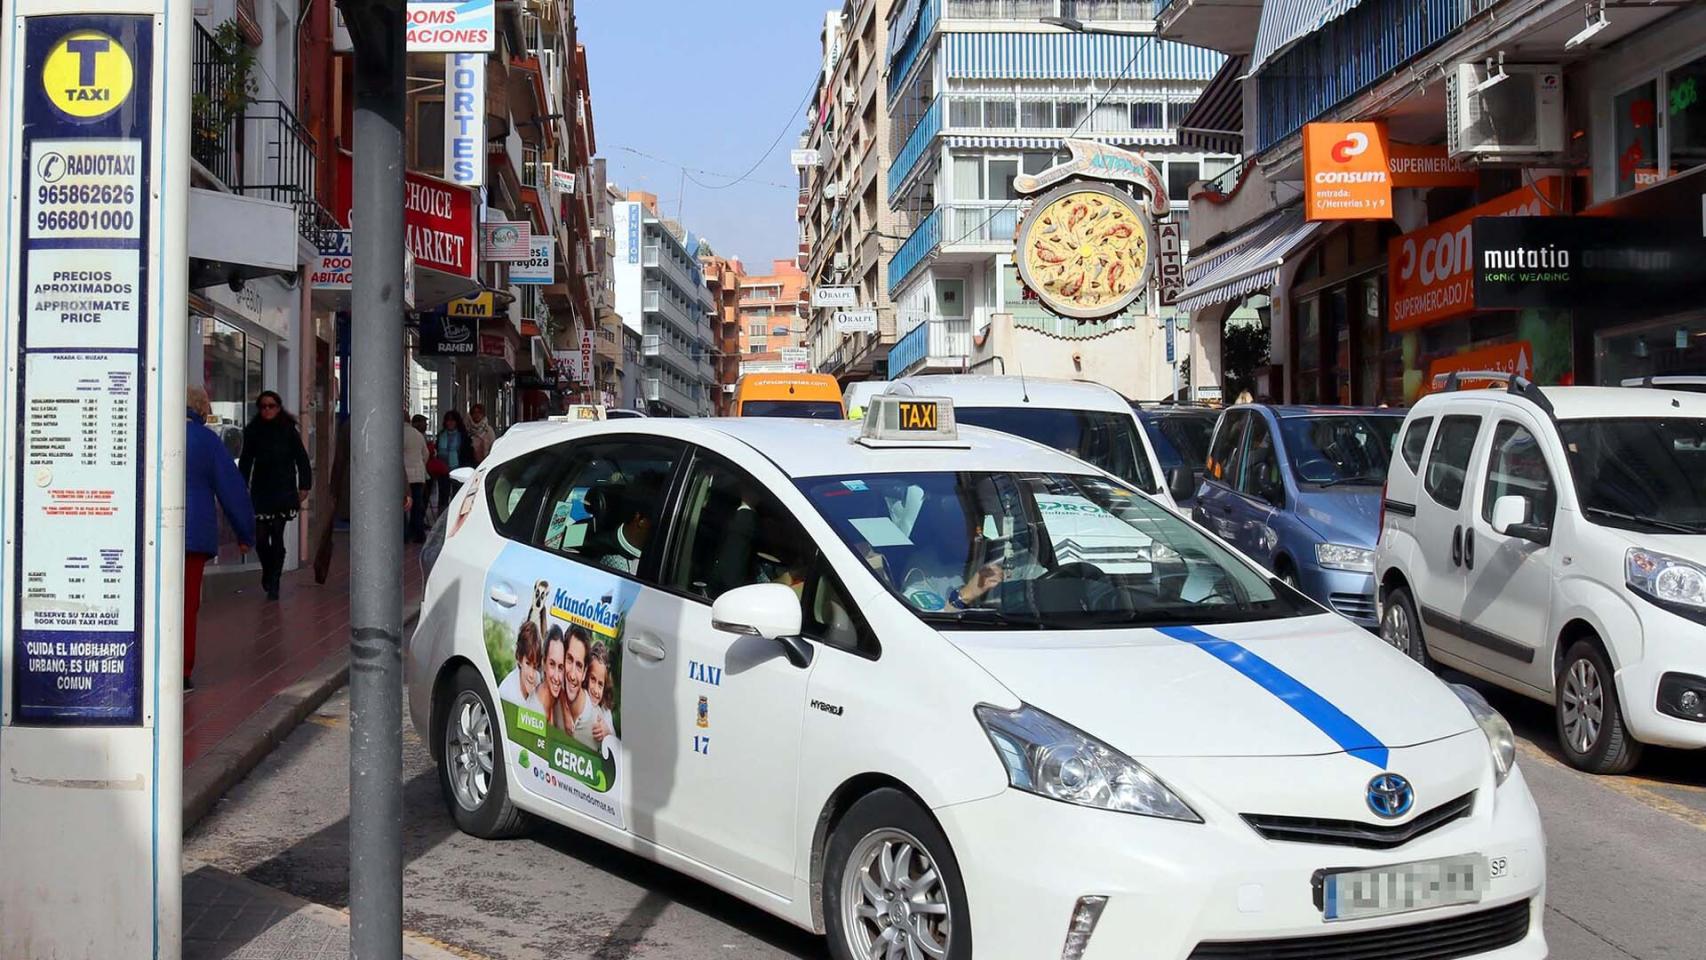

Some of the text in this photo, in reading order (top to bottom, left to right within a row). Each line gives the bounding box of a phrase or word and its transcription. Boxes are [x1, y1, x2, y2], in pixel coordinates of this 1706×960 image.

[407, 10, 456, 24] OMS
[67, 40, 110, 86] T
[65, 89, 109, 101] TAXI
[67, 154, 135, 176] RADIOTAXI
[1390, 158, 1476, 173] SUPERMERCA
[1315, 171, 1387, 184] consum
[38, 184, 134, 204] 965862626
[1365, 199, 1370, 207] 3
[1372, 200, 1378, 208] y
[1379, 199, 1385, 207] 9
[37, 210, 134, 231] 966801000
[1484, 244, 1570, 269] mutatio
[53, 271, 112, 281] PRECIOS
[34, 284, 132, 294] APROXIMADOS
[35, 301, 130, 311] APPROXIMATE
[455, 304, 486, 315] ATM
[61, 313, 102, 323] PRICE
[438, 343, 473, 352] RAMEN
[900, 404, 936, 428] TAXI
[553, 587, 619, 628] MundoMar
[27, 642, 127, 656] CUIDA EL MOBILIARIO
[29, 659, 124, 674] URBANO, ES UN BIEN
[688, 660, 721, 686] TAXI
[810, 699, 838, 715] HYBRID
[537, 739, 545, 749] DE
[694, 736, 710, 755] 17
[554, 747, 594, 780] CERCA
[1491, 860, 1506, 876] SP
